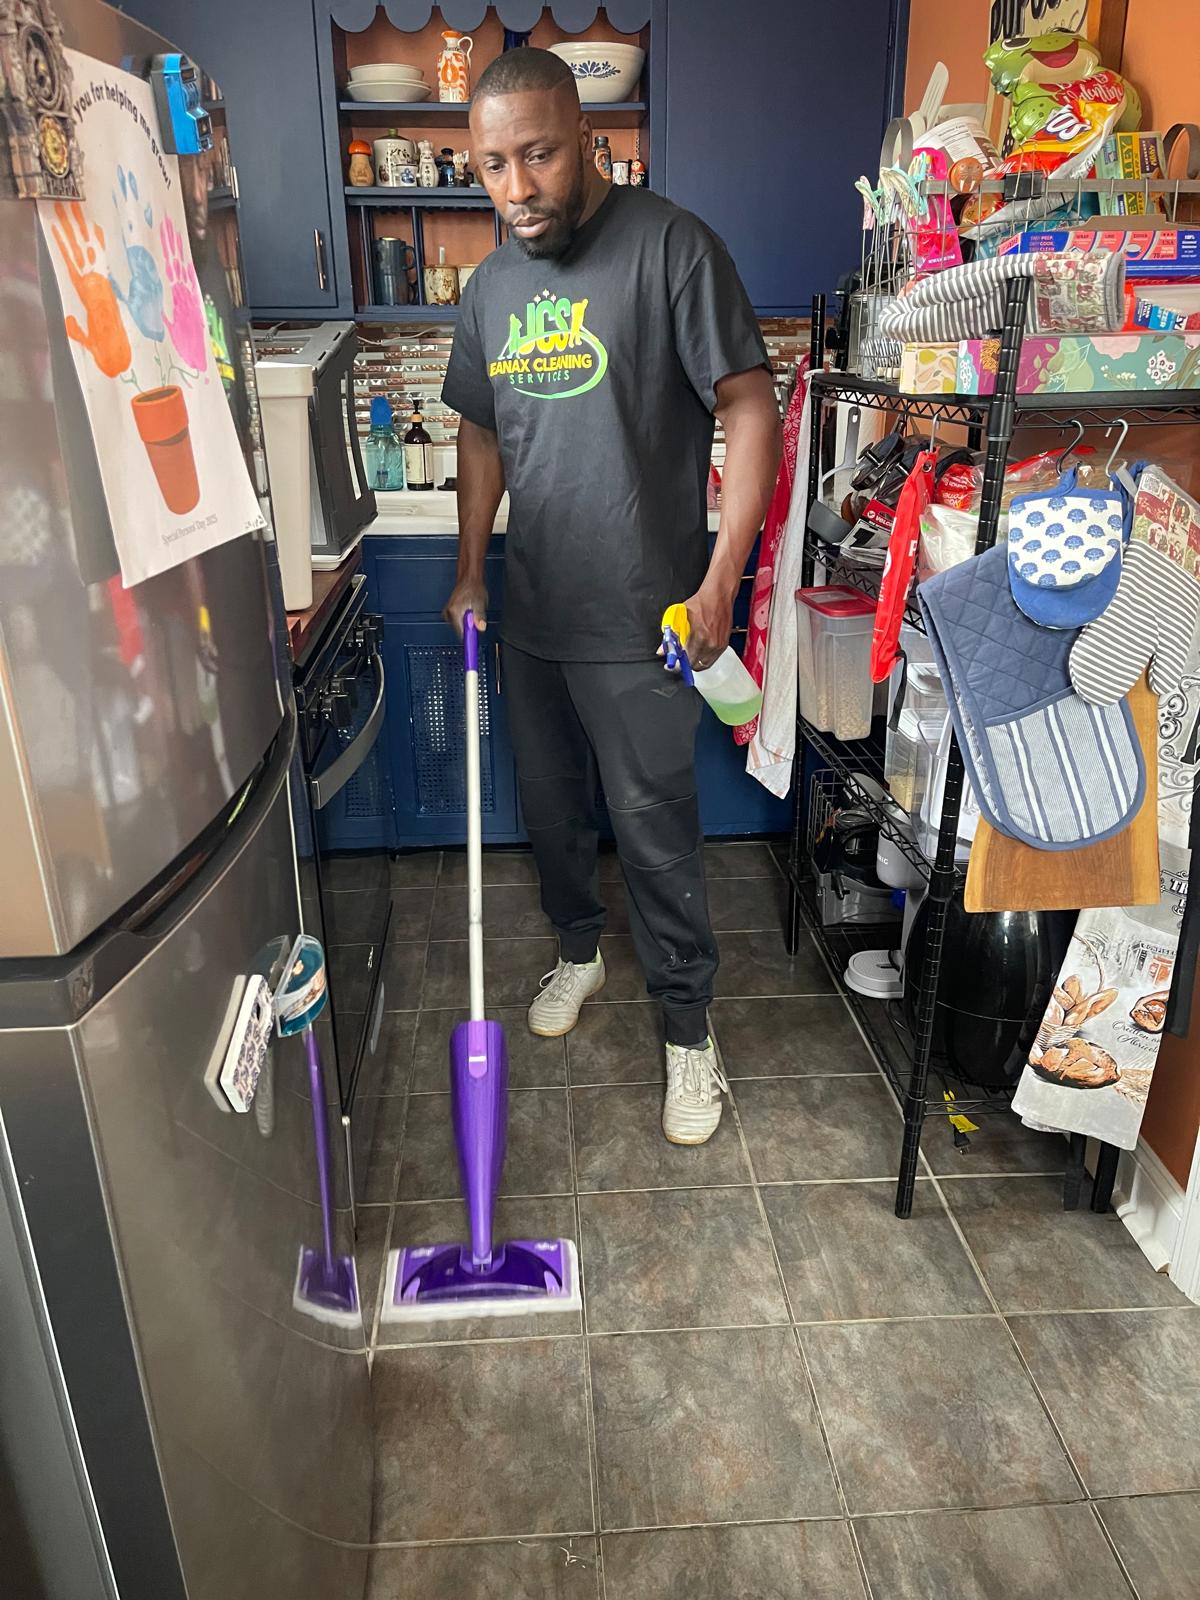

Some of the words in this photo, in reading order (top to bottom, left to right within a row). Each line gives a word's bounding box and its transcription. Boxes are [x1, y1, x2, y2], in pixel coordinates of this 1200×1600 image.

[73, 92, 93, 123] you
[90, 81, 105, 104] for
[103, 78, 138, 124] helping
[139, 112, 152, 141] me
[151, 137, 172, 190] grow!
[532, 353, 593, 373] CLEANING
[509, 370, 570, 385] SERVICES
